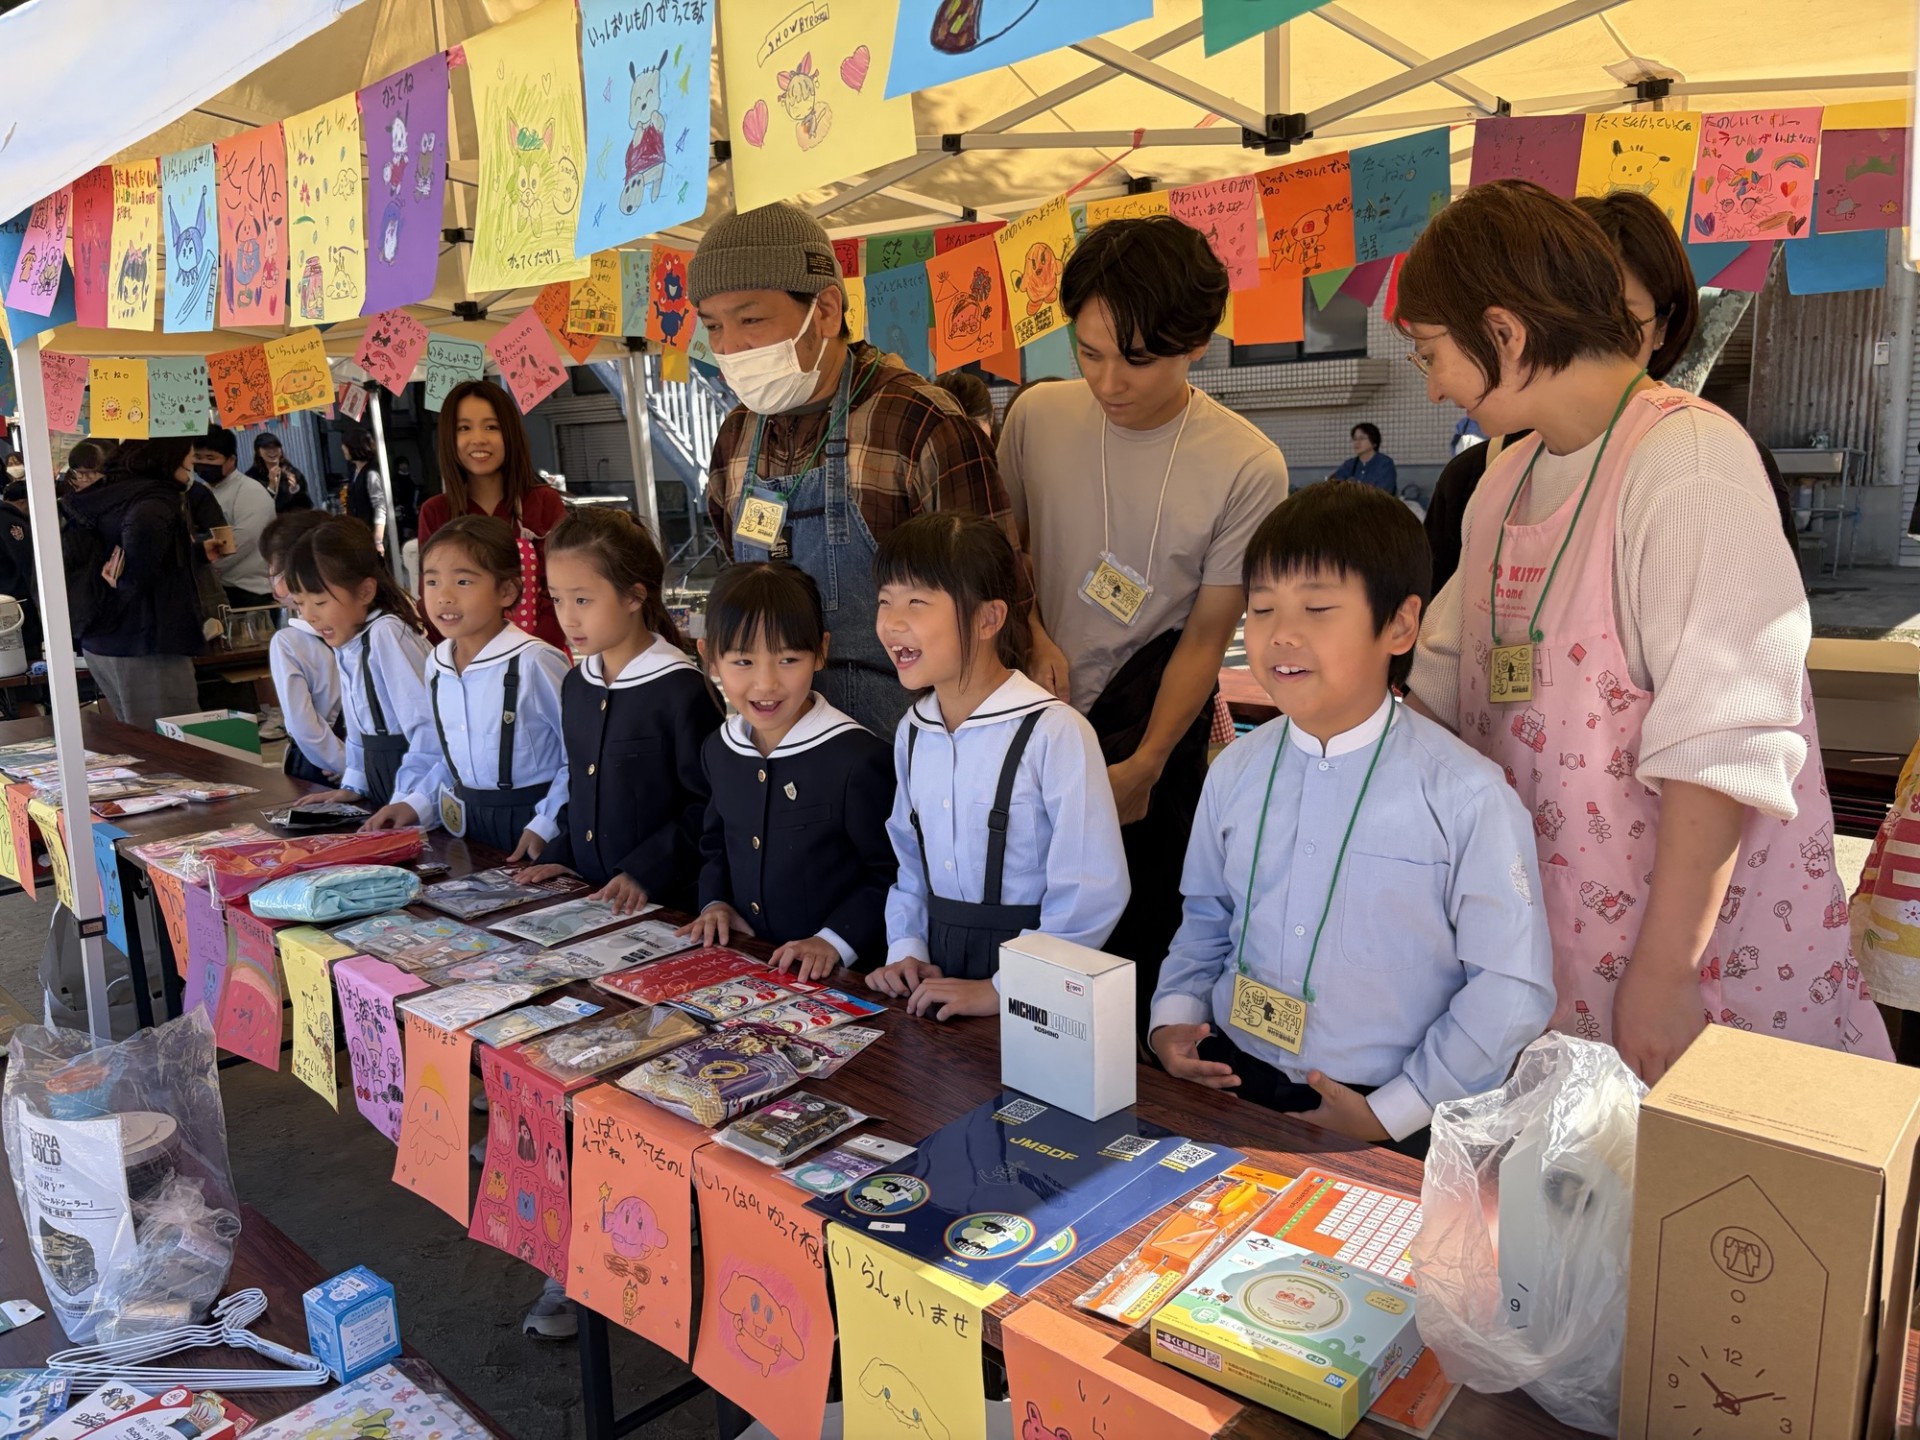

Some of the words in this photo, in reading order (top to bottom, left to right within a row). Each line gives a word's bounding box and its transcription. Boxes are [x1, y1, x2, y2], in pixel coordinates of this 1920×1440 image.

[382, 72, 414, 109] かってね
[222, 140, 282, 213] きてね
[1508, 566, 1547, 583] KITTY
[1008, 997, 1048, 1027] MICHIKO
[1047, 1010, 1087, 1041] LONDON
[1033, 1025, 1060, 1040] KOSHINO
[31, 1141, 62, 1166] COLD
[1009, 1136, 1079, 1161] JMSDF
[888, 1175, 923, 1191] JMSDF
[855, 1197, 885, 1214] RECRUIT
[990, 1214, 1027, 1230] JMSDF
[955, 1239, 990, 1257] RECRUIT
[831, 1239, 969, 1339] いらっしゃいませ
[1509, 1297, 1522, 1313] 9
[1723, 1347, 1743, 1367] 12
[1667, 1373, 1679, 1389] 9
[1779, 1417, 1793, 1434] 3
